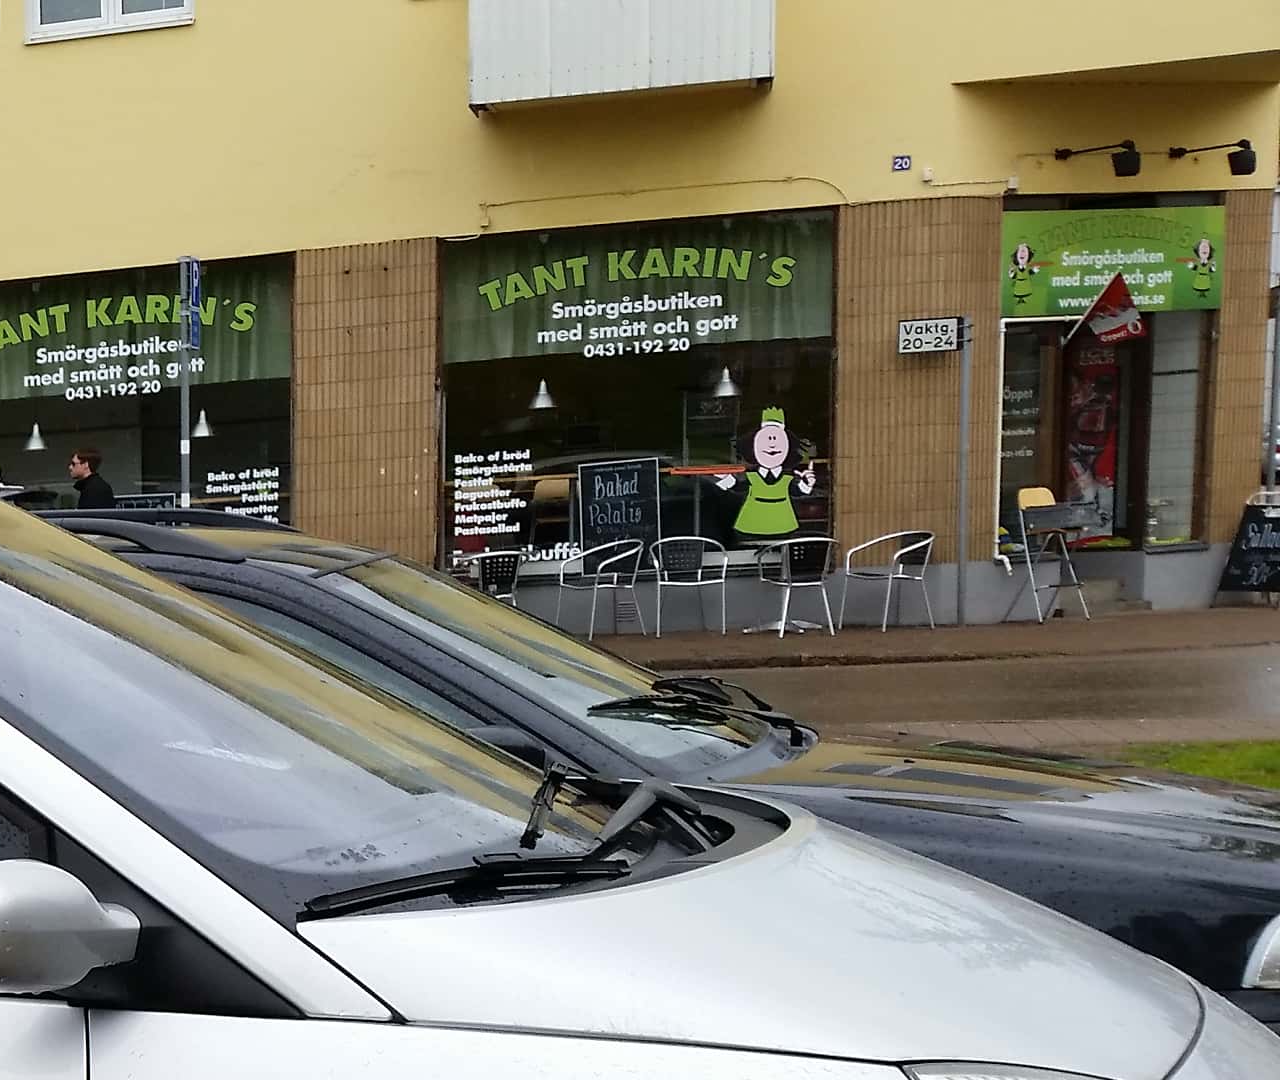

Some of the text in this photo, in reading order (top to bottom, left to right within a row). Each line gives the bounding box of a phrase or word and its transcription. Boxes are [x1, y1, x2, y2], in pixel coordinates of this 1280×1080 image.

[893, 158, 910, 170] 20
[1061, 249, 1164, 269] Smörgåsbutiken
[478, 255, 589, 312] TANT
[1052, 271, 1080, 286] med
[1123, 269, 1144, 284] och
[1147, 270, 1173, 288] gott
[551, 291, 723, 320] Smörgåsbutiken
[537, 314, 739, 344] med smått och gott
[903, 323, 954, 336] Vaktg.
[583, 337, 690, 358] 0431-192 20
[902, 336, 954, 350] 20-24
[23, 368, 64, 387] med
[70, 361, 122, 383] smått
[128, 359, 160, 378] och
[65, 380, 161, 401] 0431-192 20
[454, 452, 484, 464] Bake
[502, 449, 530, 460] bröd
[207, 471, 235, 482] Bake
[253, 467, 279, 478] bröd
[454, 463, 533, 476] Smörgåstårta
[205, 481, 279, 494] Smörgåstårta
[454, 477, 494, 488] Festfat
[241, 492, 279, 503] Festfat
[454, 489, 512, 501] Baguetter
[225, 505, 279, 516] Baguetter
[454, 512, 509, 525] Matpajer
[454, 523, 520, 536] Pastasallad
